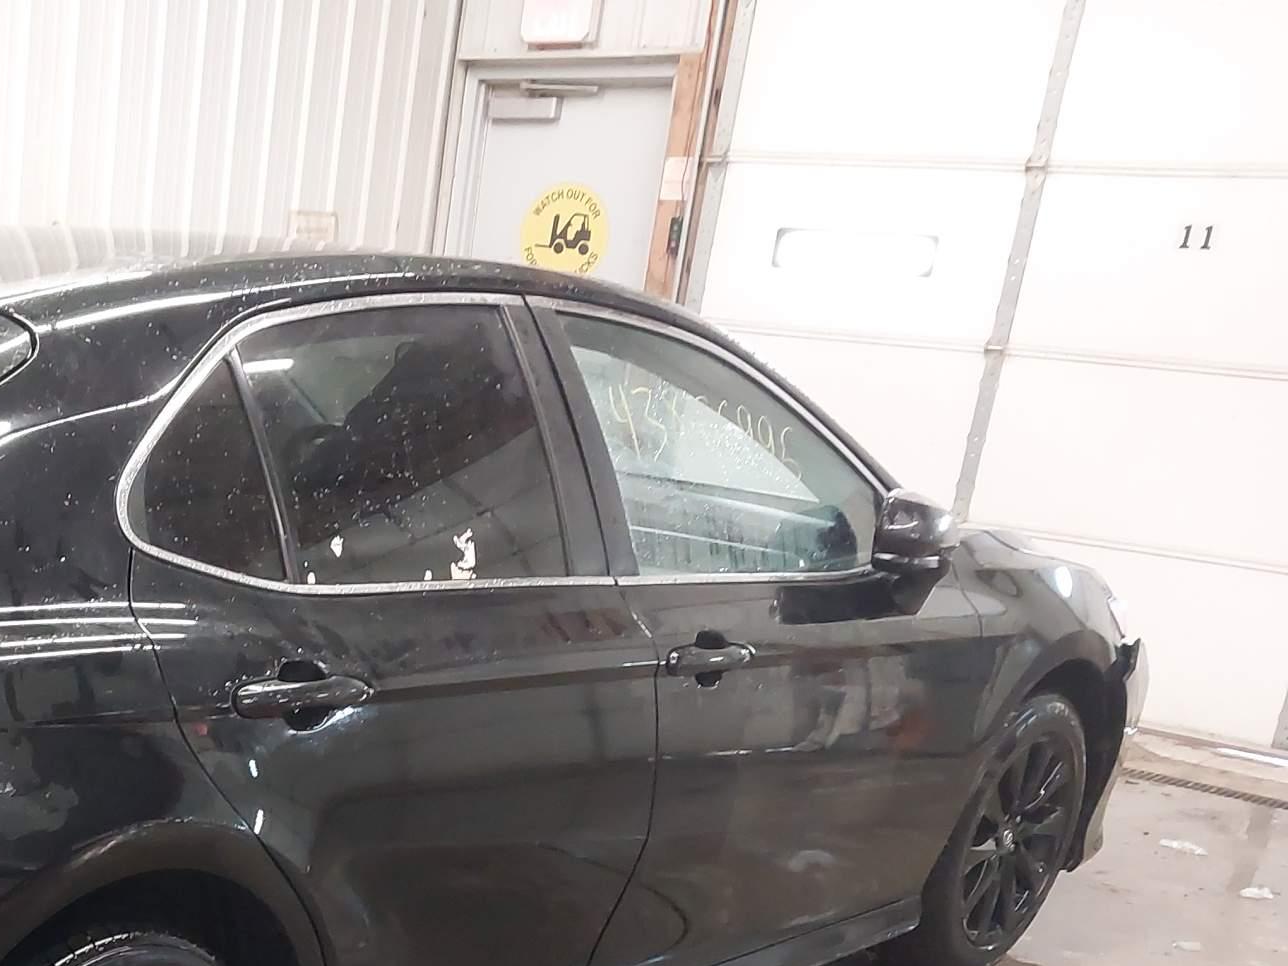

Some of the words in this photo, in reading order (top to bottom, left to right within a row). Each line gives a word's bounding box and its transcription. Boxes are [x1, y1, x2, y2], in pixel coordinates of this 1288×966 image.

[533, 189, 564, 216] WATCH
[566, 188, 586, 202] OUT
[585, 196, 601, 219] FOR
[1178, 224, 1214, 250] 11
